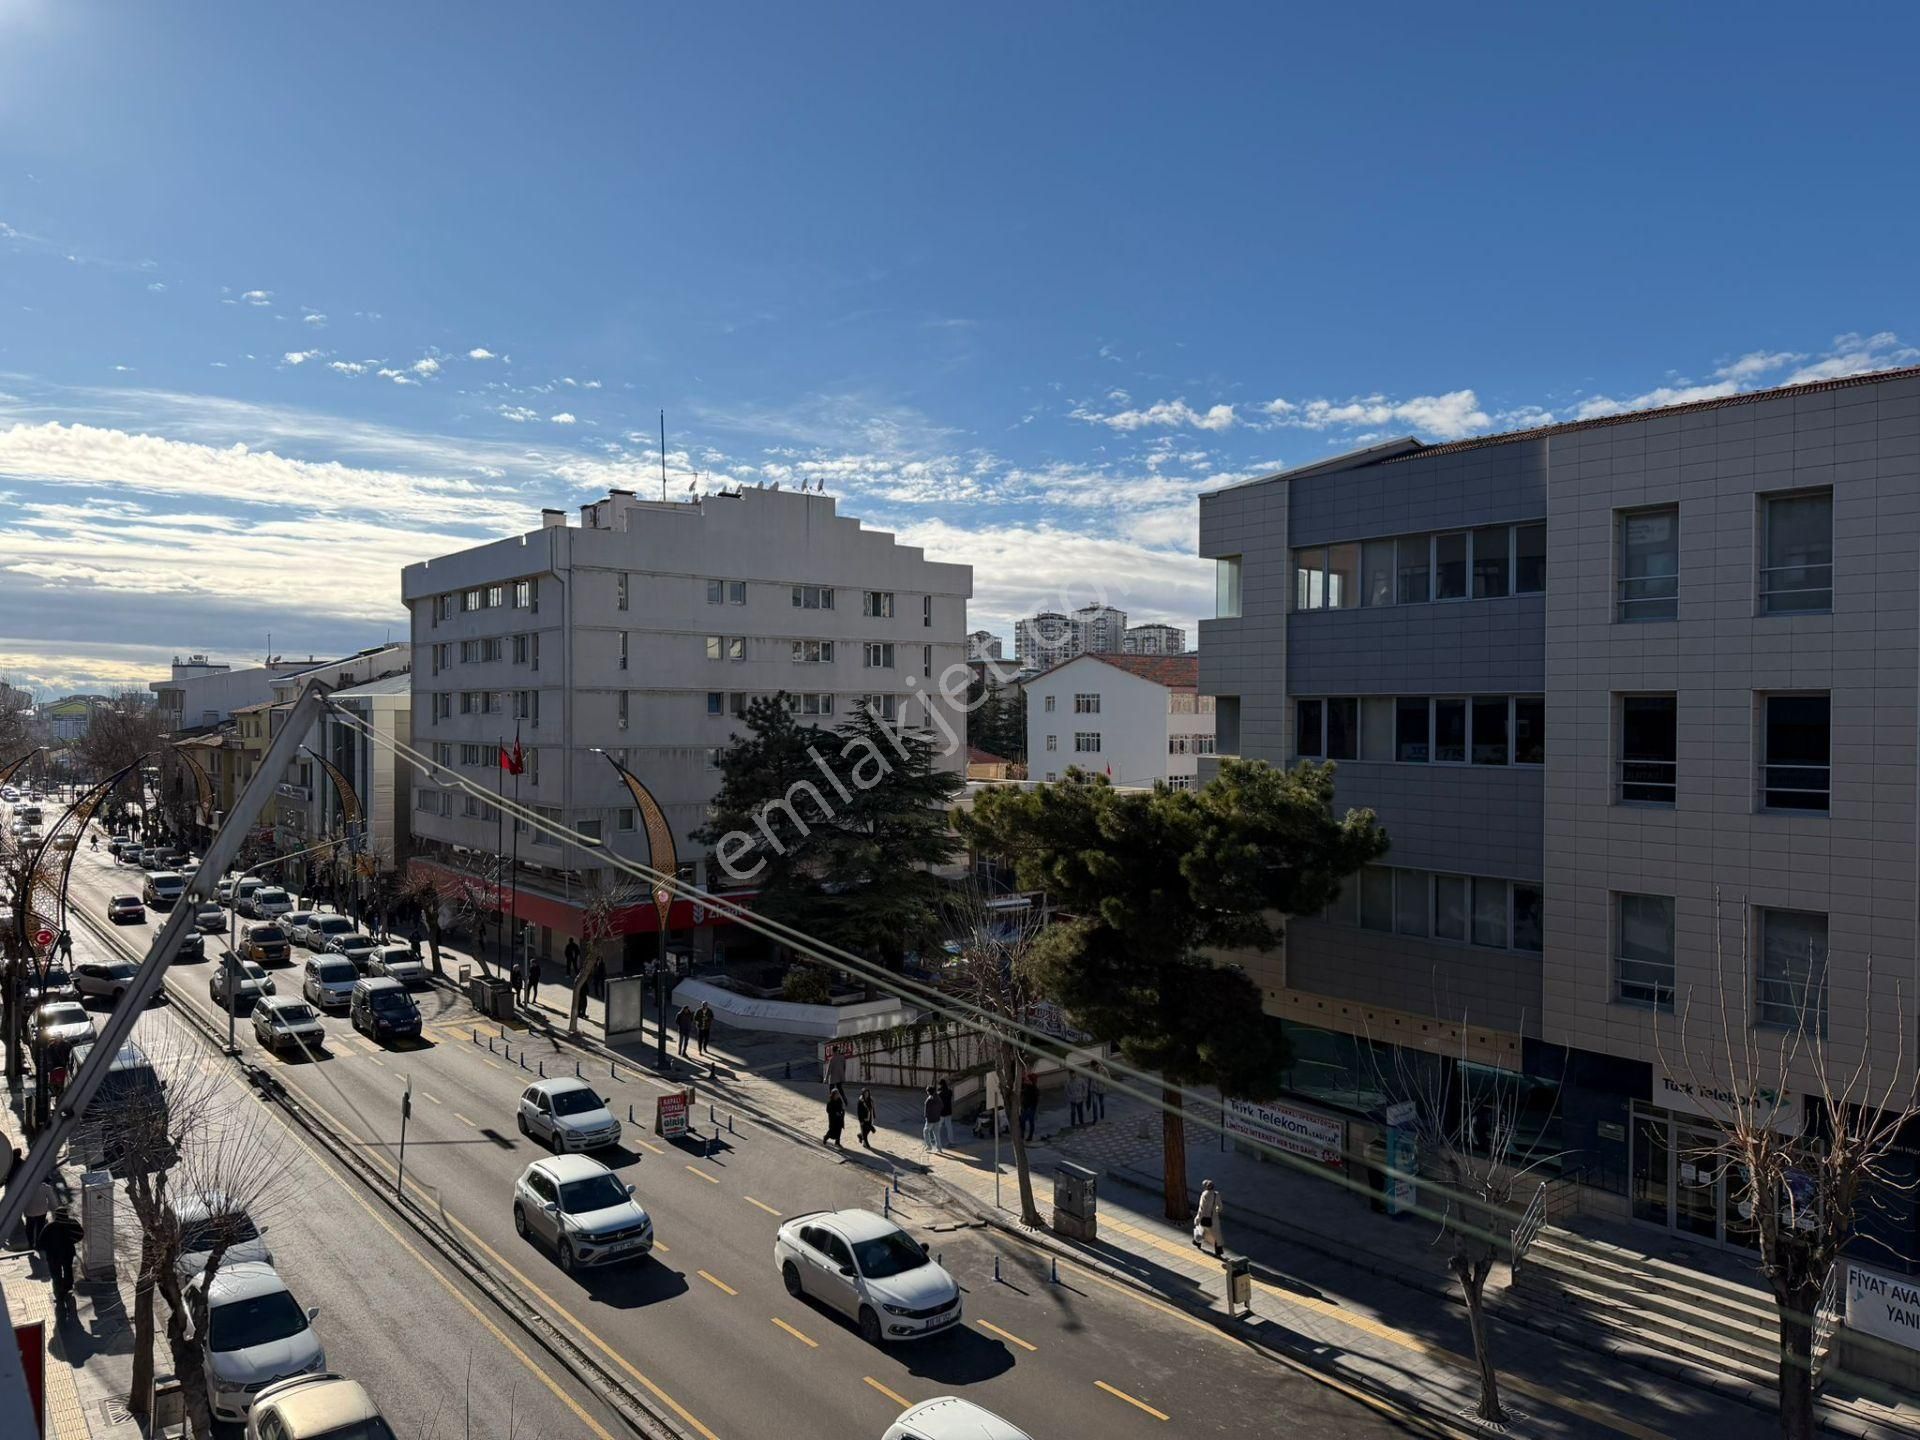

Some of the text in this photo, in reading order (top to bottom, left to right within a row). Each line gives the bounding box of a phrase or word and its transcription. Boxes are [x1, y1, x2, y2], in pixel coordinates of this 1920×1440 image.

[1258, 1108, 1308, 1136] Telekom
[1849, 1269, 1920, 1307] FİYAT AVA
[1886, 1303, 1920, 1330] YANI
